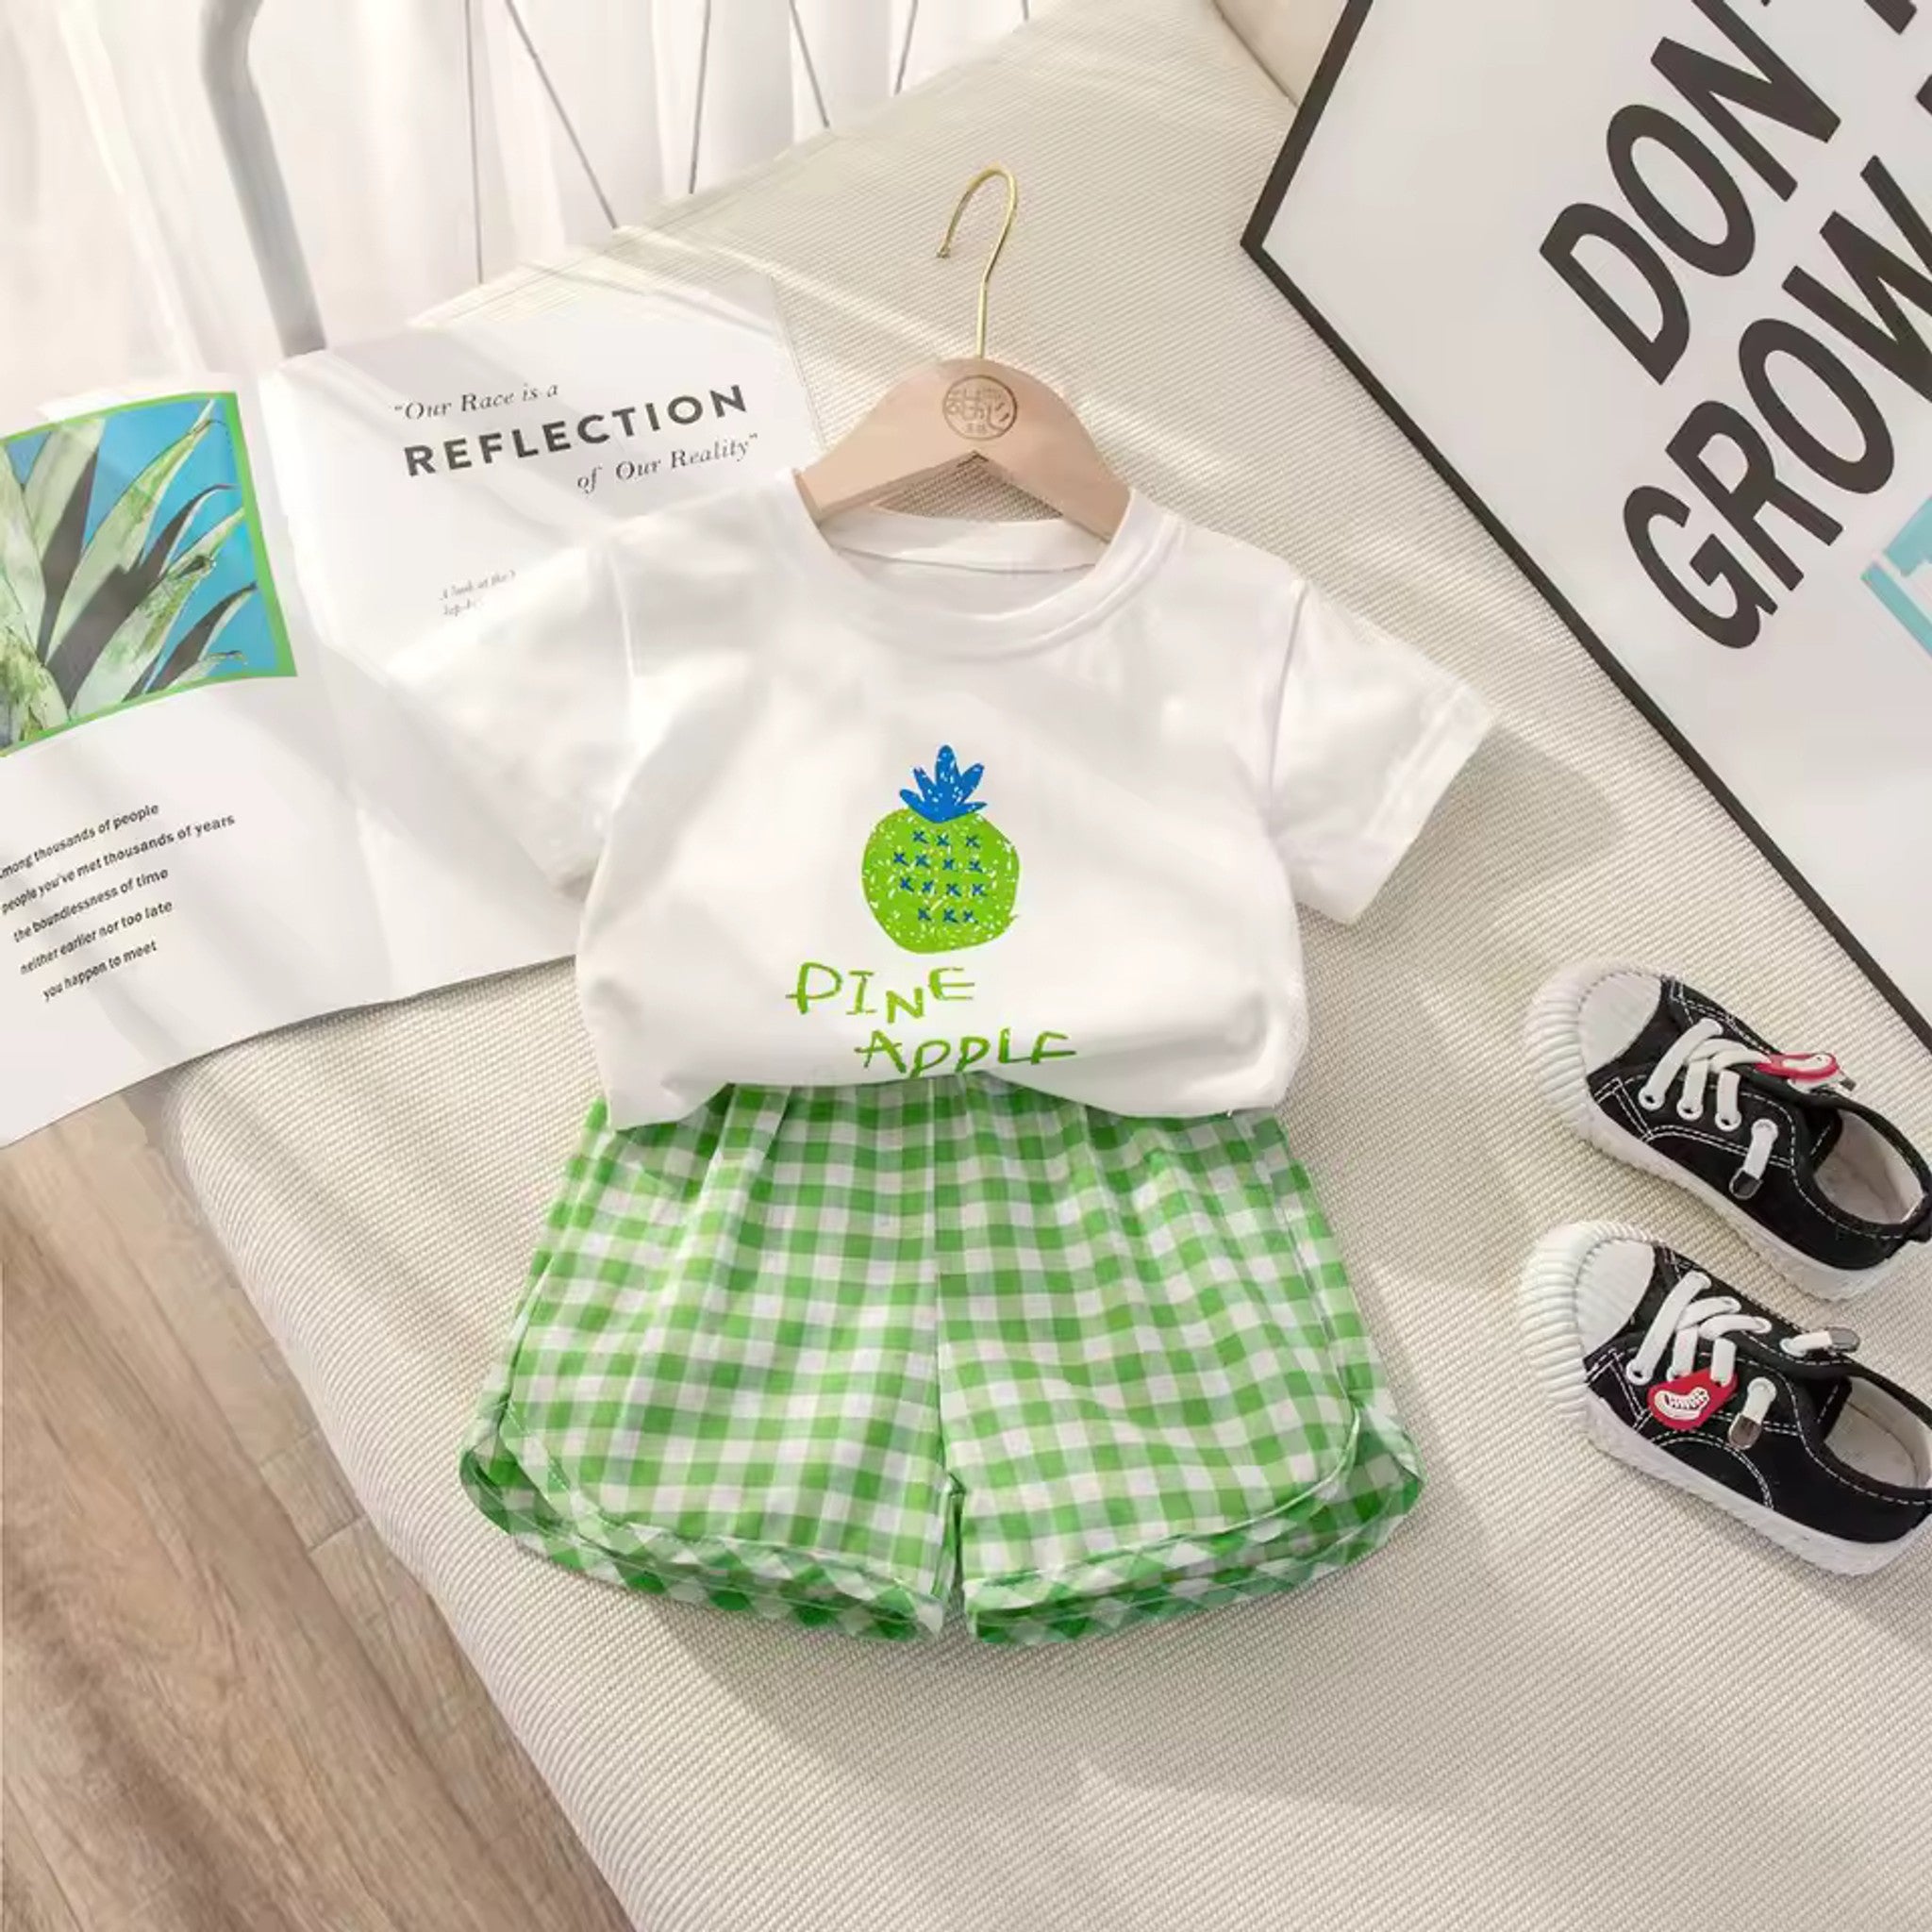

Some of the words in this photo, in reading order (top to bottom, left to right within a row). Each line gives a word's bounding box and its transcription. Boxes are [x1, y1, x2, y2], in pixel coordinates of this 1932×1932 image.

[1540, 0, 1918, 386] DON
[404, 384, 747, 476] REFLECTION
[461, 388, 515, 411] Race
[522, 383, 539, 402] is
[546, 383, 558, 397] a
[1623, 155, 1932, 649] GROW
[576, 464, 603, 494] of
[615, 458, 661, 482] Our
[2, 889, 38, 915] people
[76, 857, 102, 877] met
[103, 833, 175, 867] thousands
[176, 824, 192, 840] of
[194, 814, 236, 838] years
[34, 827, 95, 862] thousands
[98, 819, 110, 834] of
[112, 804, 159, 831] people
[13, 927, 31, 943] the
[32, 887, 118, 934] boundlessness
[120, 877, 134, 893] of
[136, 868, 169, 889] time
[20, 948, 58, 975] neither
[59, 929, 96, 956] earlier
[98, 921, 119, 938] nor
[121, 910, 142, 928] too
[144, 901, 173, 920] late
[42, 983, 63, 1003] you
[64, 960, 108, 990] happen
[108, 956, 122, 971] to
[124, 940, 158, 964] meet
[785, 961, 975, 1024] PINE
